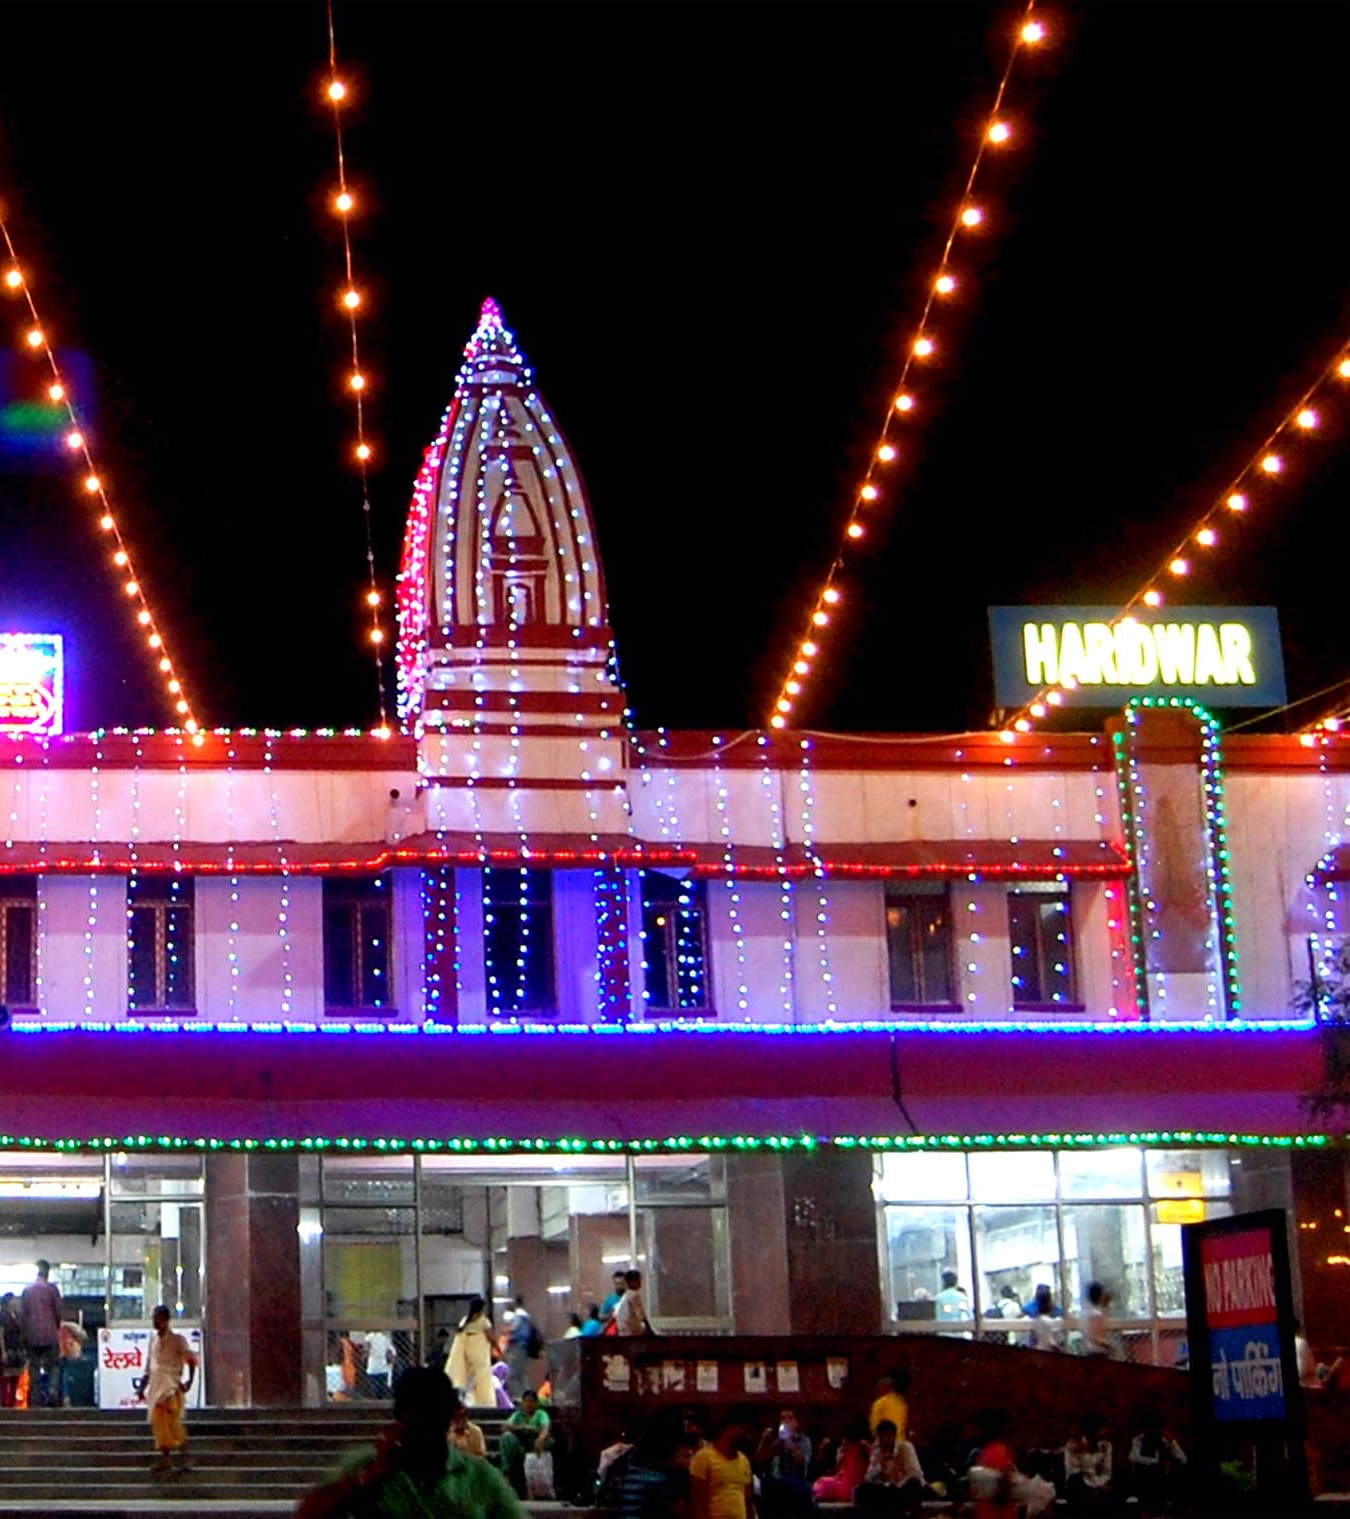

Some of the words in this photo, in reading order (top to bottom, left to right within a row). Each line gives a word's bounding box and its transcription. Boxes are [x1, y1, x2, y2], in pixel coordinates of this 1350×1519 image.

[1024, 622, 1256, 686] HARIDWAR
[1204, 1262, 1221, 1314] NO
[1222, 1253, 1277, 1312] PARKING
[103, 1346, 143, 1369] रेलवे
